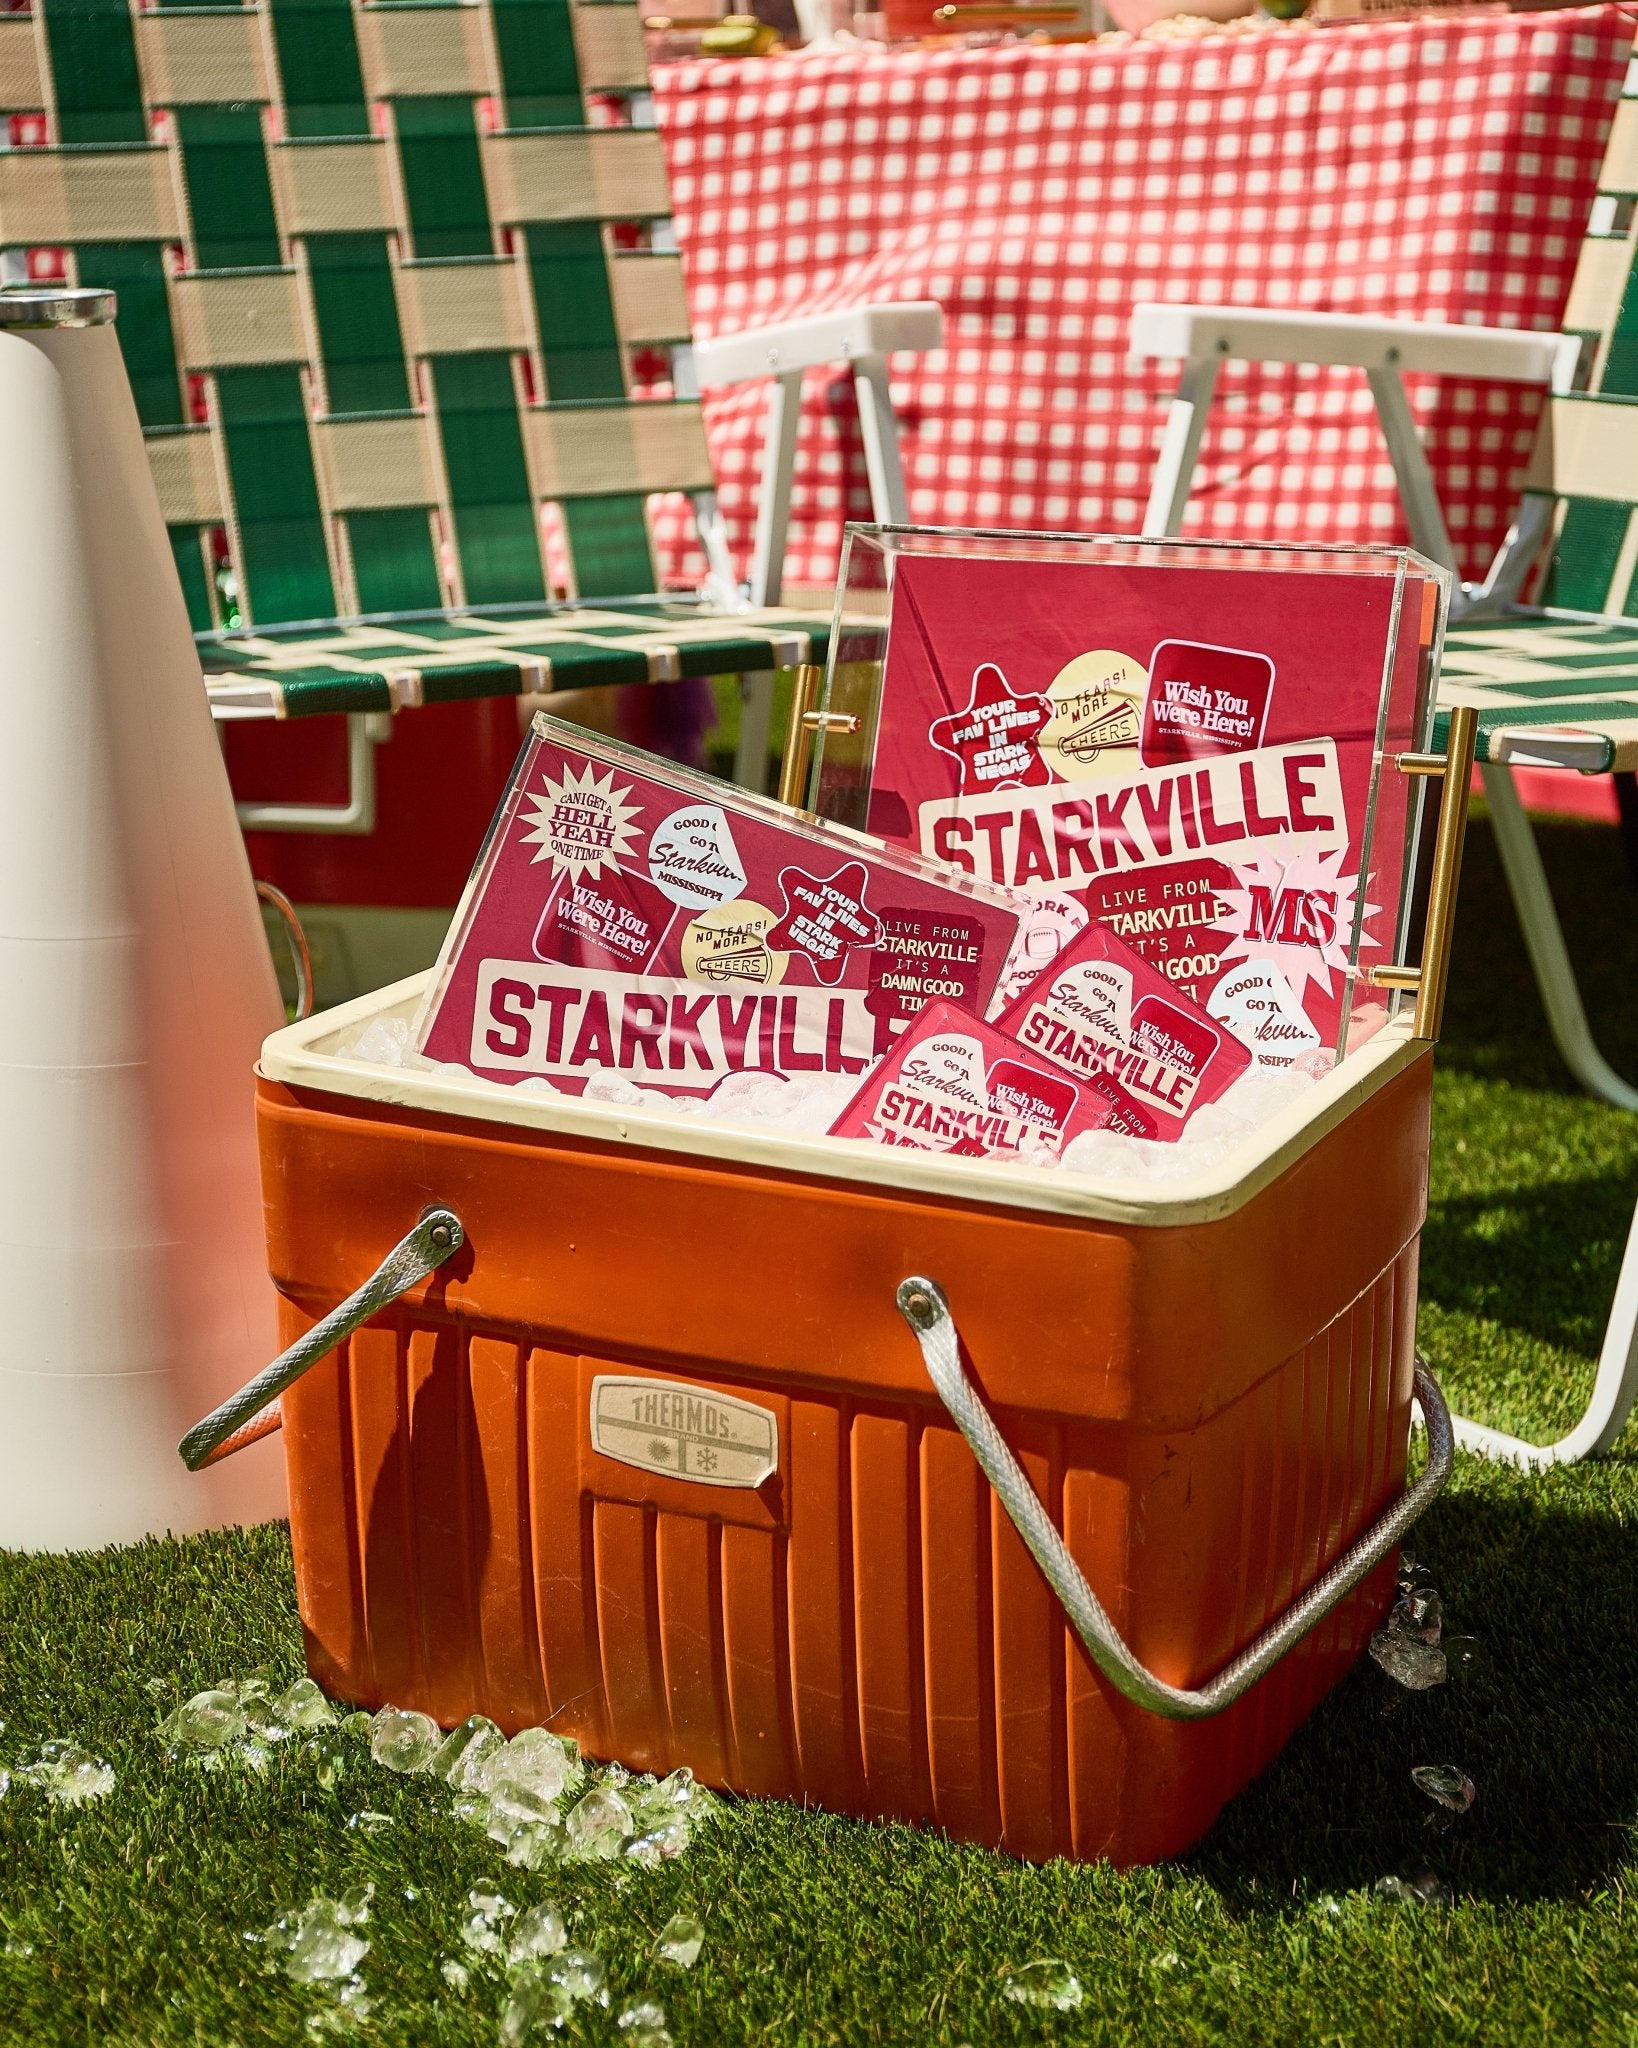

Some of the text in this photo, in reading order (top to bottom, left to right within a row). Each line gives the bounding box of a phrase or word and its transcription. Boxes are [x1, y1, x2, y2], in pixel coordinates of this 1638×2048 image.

[1075, 668, 1126, 707] TEARS!
[1164, 681, 1248, 715] Wish You
[971, 700, 1017, 723] YOUR
[1072, 692, 1108, 723] MORE
[1152, 700, 1255, 737] Were Here!
[952, 710, 1041, 745] FAV LIVES
[988, 730, 1008, 749] IN
[1070, 720, 1131, 748] CHEERS
[973, 741, 1029, 767] STARK
[974, 754, 1031, 781] VEGAS
[552, 804, 617, 831] HELL
[674, 818, 710, 830] GOOD
[933, 753, 1335, 887] STARKVILLE
[549, 820, 615, 848] YEAH
[690, 836, 707, 847] GO
[551, 840, 604, 861] ONE TIME
[657, 871, 724, 901] MISSISSIPPI
[820, 884, 860, 915] YOUR
[1101, 879, 1211, 909] LIVE FROM
[573, 885, 648, 937] Wish You
[793, 886, 870, 937] FAV LIVES
[816, 912, 835, 931] IN
[1098, 900, 1228, 936] TARKVILLE
[1243, 885, 1338, 949] MS
[557, 897, 651, 957] Were Here!
[696, 920, 767, 943] NO TEARS!
[794, 914, 844, 950] STARK
[886, 921, 969, 940] LIVE FROM
[713, 934, 748, 949] MORE
[788, 924, 838, 960] VEGAS
[877, 936, 978, 963] STARKVILLE
[1128, 933, 1196, 955] T'S A
[707, 959, 760, 972] CHEERS
[896, 959, 949, 975] IT'S A
[1083, 969, 1117, 986] GOOD
[1166, 953, 1220, 980] GOOD
[881, 973, 963, 997] DAMN GOOD
[1092, 988, 1108, 1001] GO
[1225, 976, 1263, 998] GOOD
[1246, 999, 1265, 1011] GO
[932, 1043, 967, 1056] GOOD
[1131, 1031, 1196, 1075] Were Here!
[1139, 1019, 1196, 1064] Wish You
[943, 1059, 960, 1072] GO
[1024, 1011, 1194, 1111] STARKVILLE
[987, 1094, 1019, 1117] Were
[996, 1083, 1056, 1118] Wish You
[1097, 1080, 1121, 1106] LIVE
[1122, 1108, 1147, 1134] FROM
[880, 1089, 1058, 1150] STARKVIL
